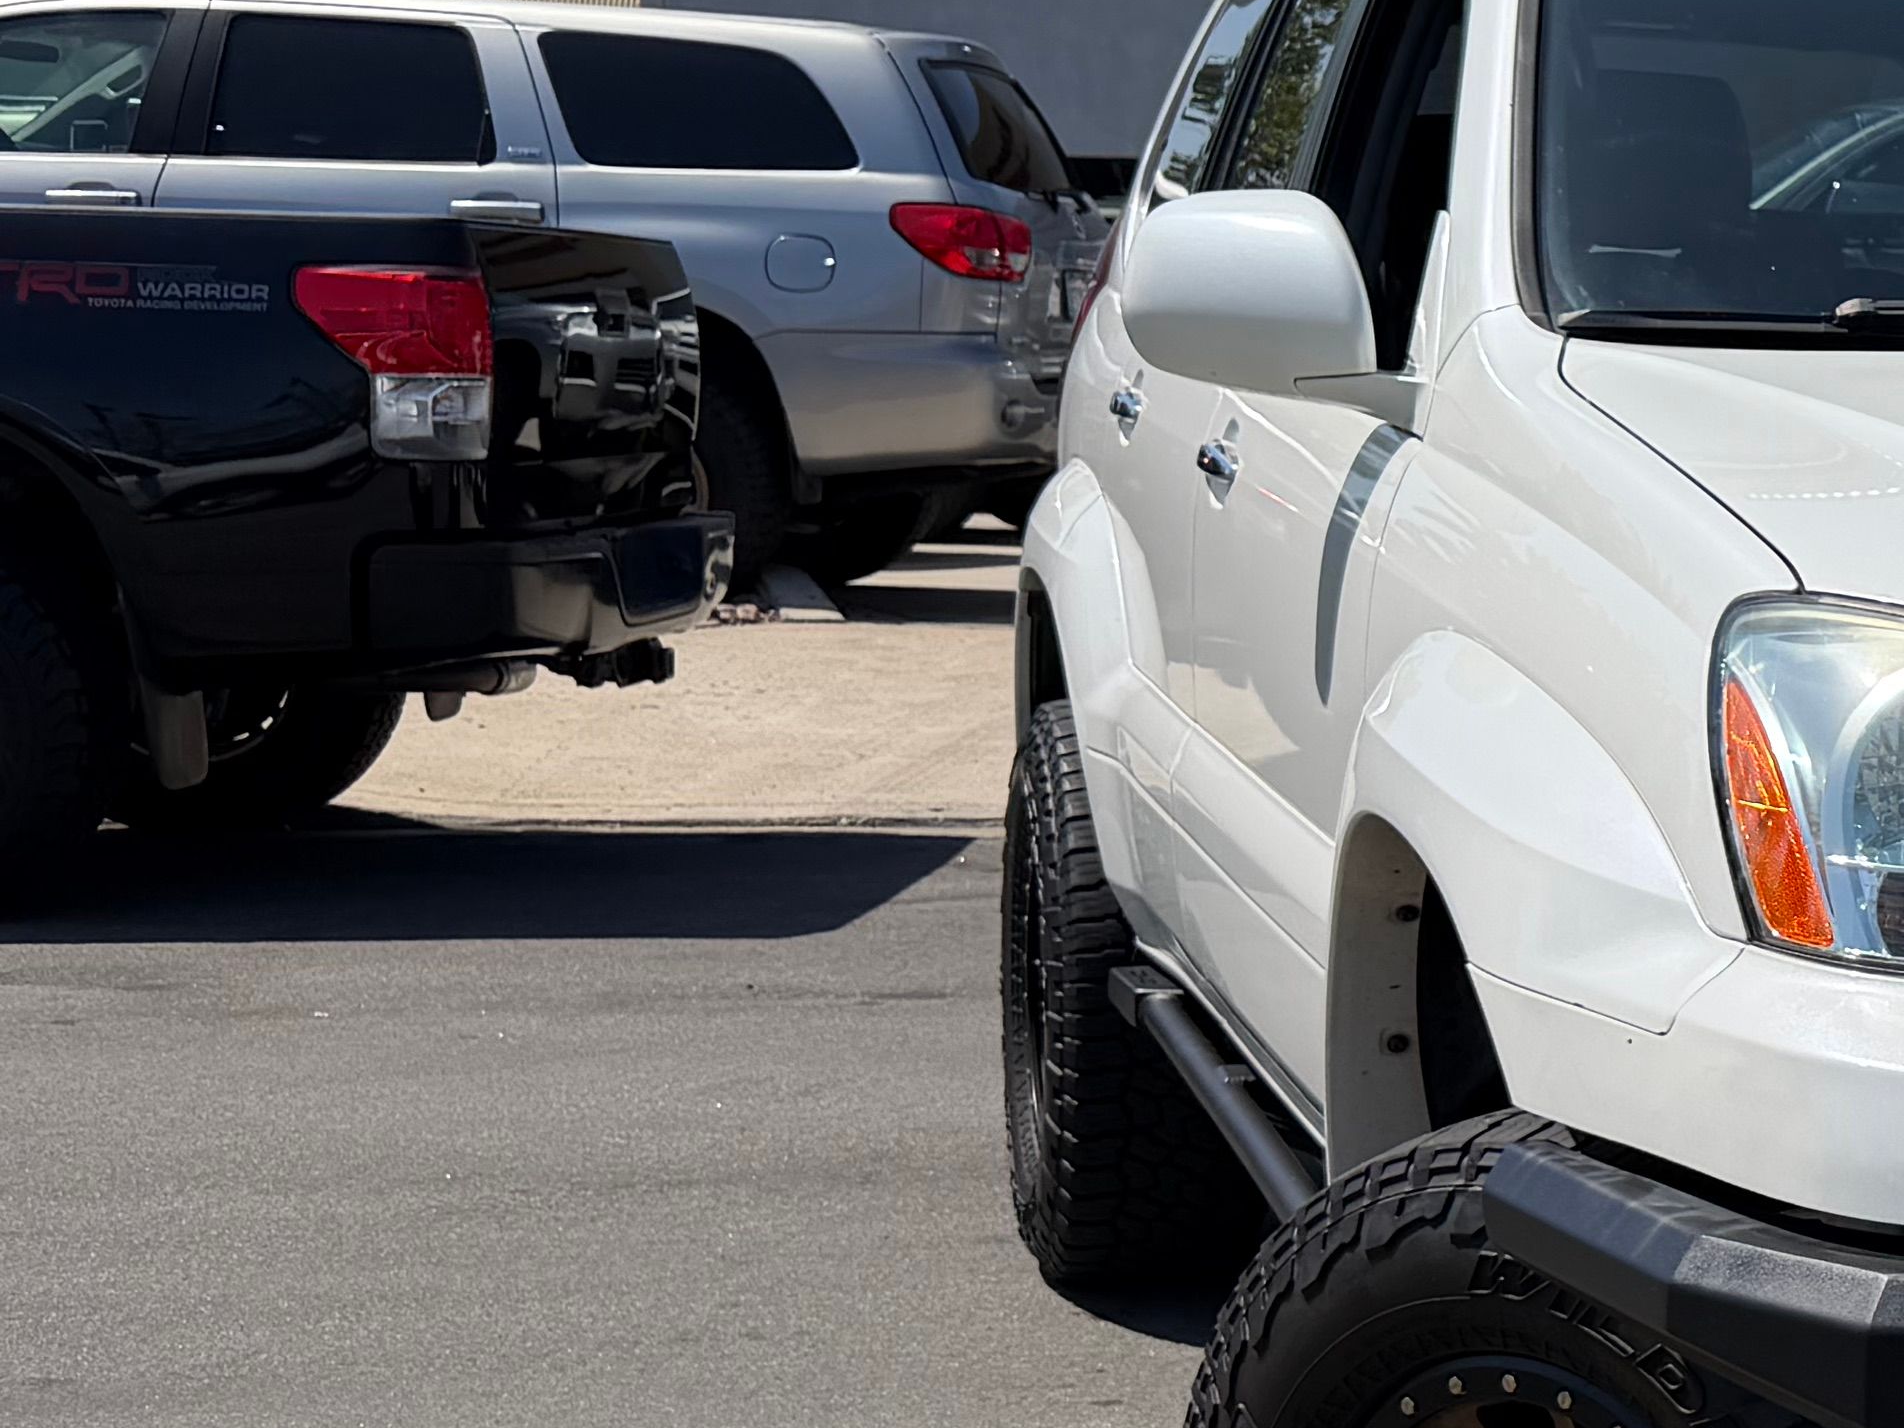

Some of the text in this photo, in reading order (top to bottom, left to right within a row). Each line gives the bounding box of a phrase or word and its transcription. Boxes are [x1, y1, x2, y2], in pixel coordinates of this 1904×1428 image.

[136, 281, 270, 301] WARRIOR
[87, 296, 268, 313] TOYOTA RACING DEVELOPMENT
